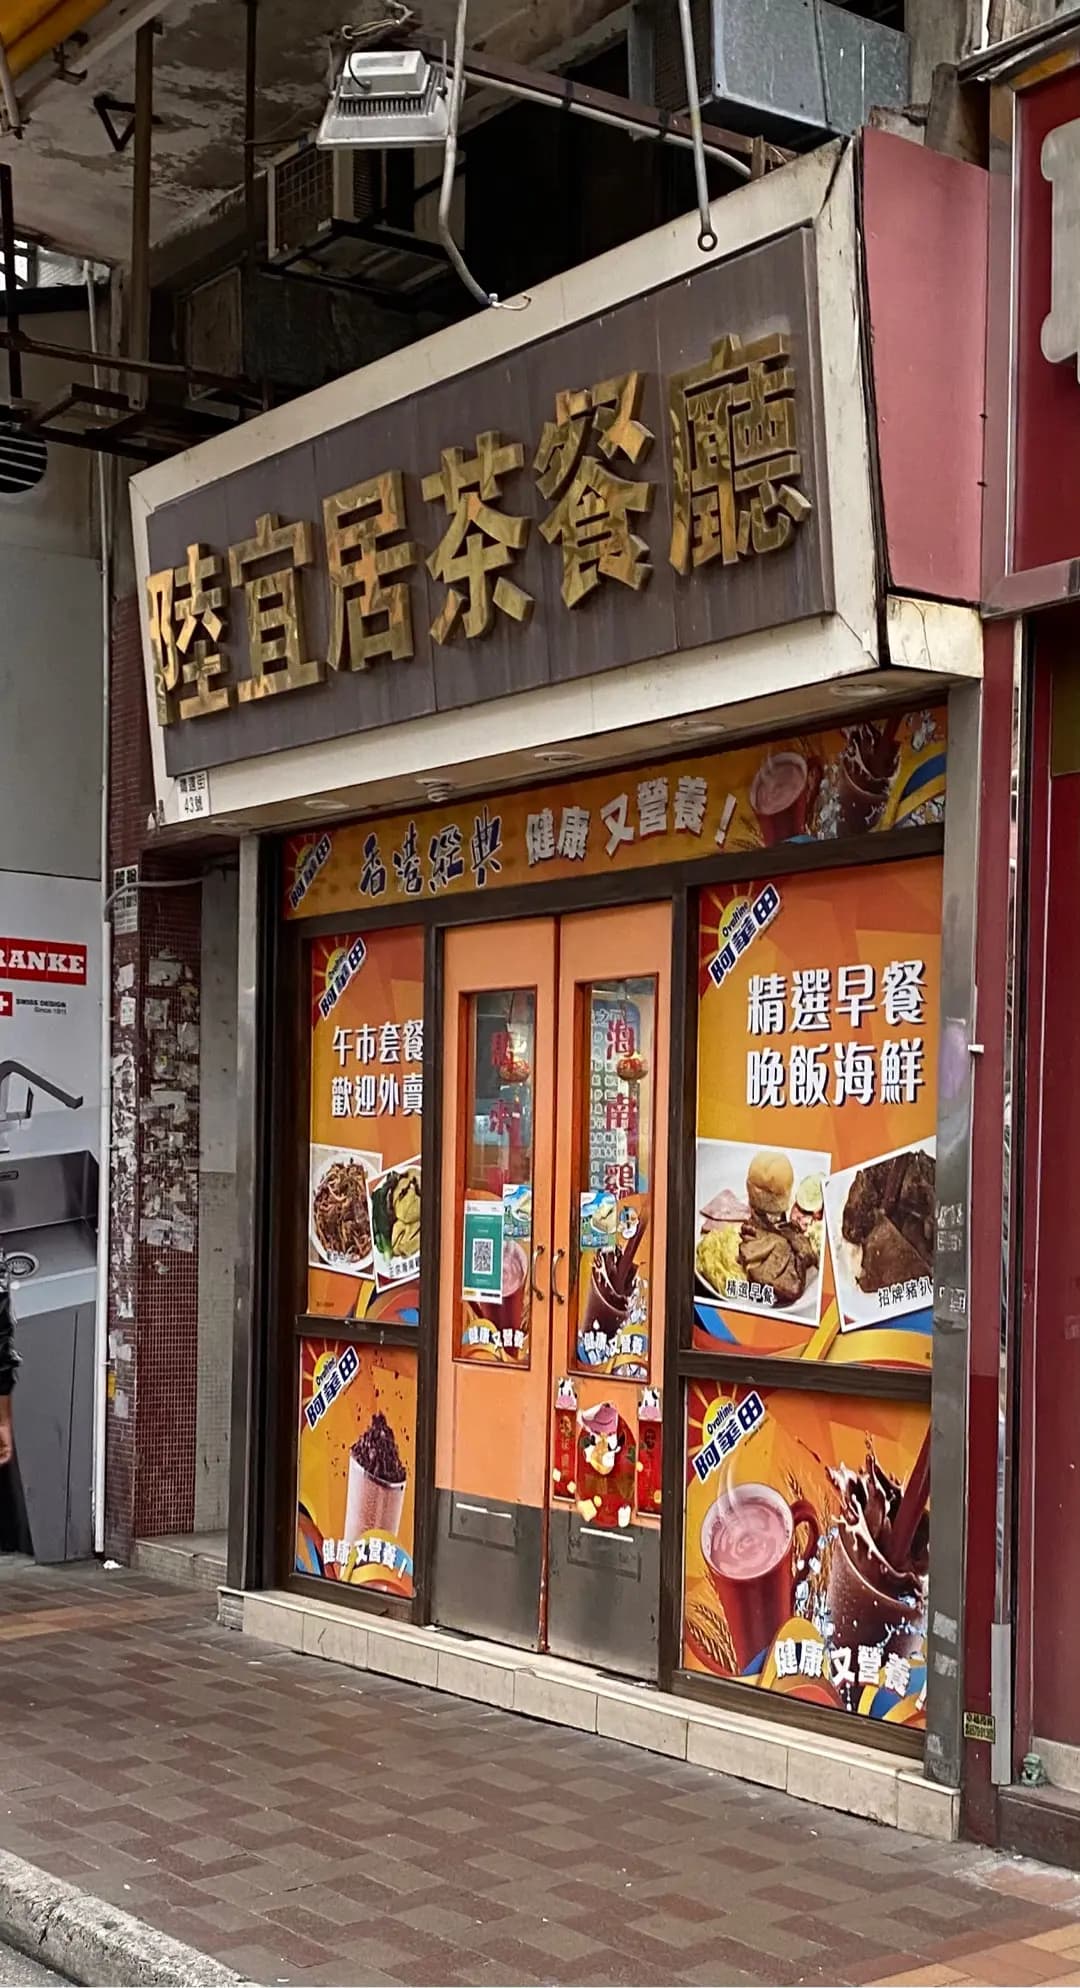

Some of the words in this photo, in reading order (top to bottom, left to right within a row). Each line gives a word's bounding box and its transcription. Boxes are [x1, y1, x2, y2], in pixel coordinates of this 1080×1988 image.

[146, 332, 812, 726] 陸宜居茶餐廳
[359, 804, 502, 897] 香港經典
[708, 883, 780, 988] 阿華田
[722, 901, 750, 938] Ovaltine
[747, 959, 928, 1035] 精選早餐
[332, 1019, 424, 1067] 午市套餐
[746, 1037, 926, 1108] 晚飯海鮮
[331, 1072, 423, 1118] 歡迎外賣
[726, 1279, 774, 1305] 精選早餐
[305, 1345, 359, 1431] 阿華田
[707, 1402, 734, 1435] Ovaltine
[693, 1391, 765, 1483] 阿華田
